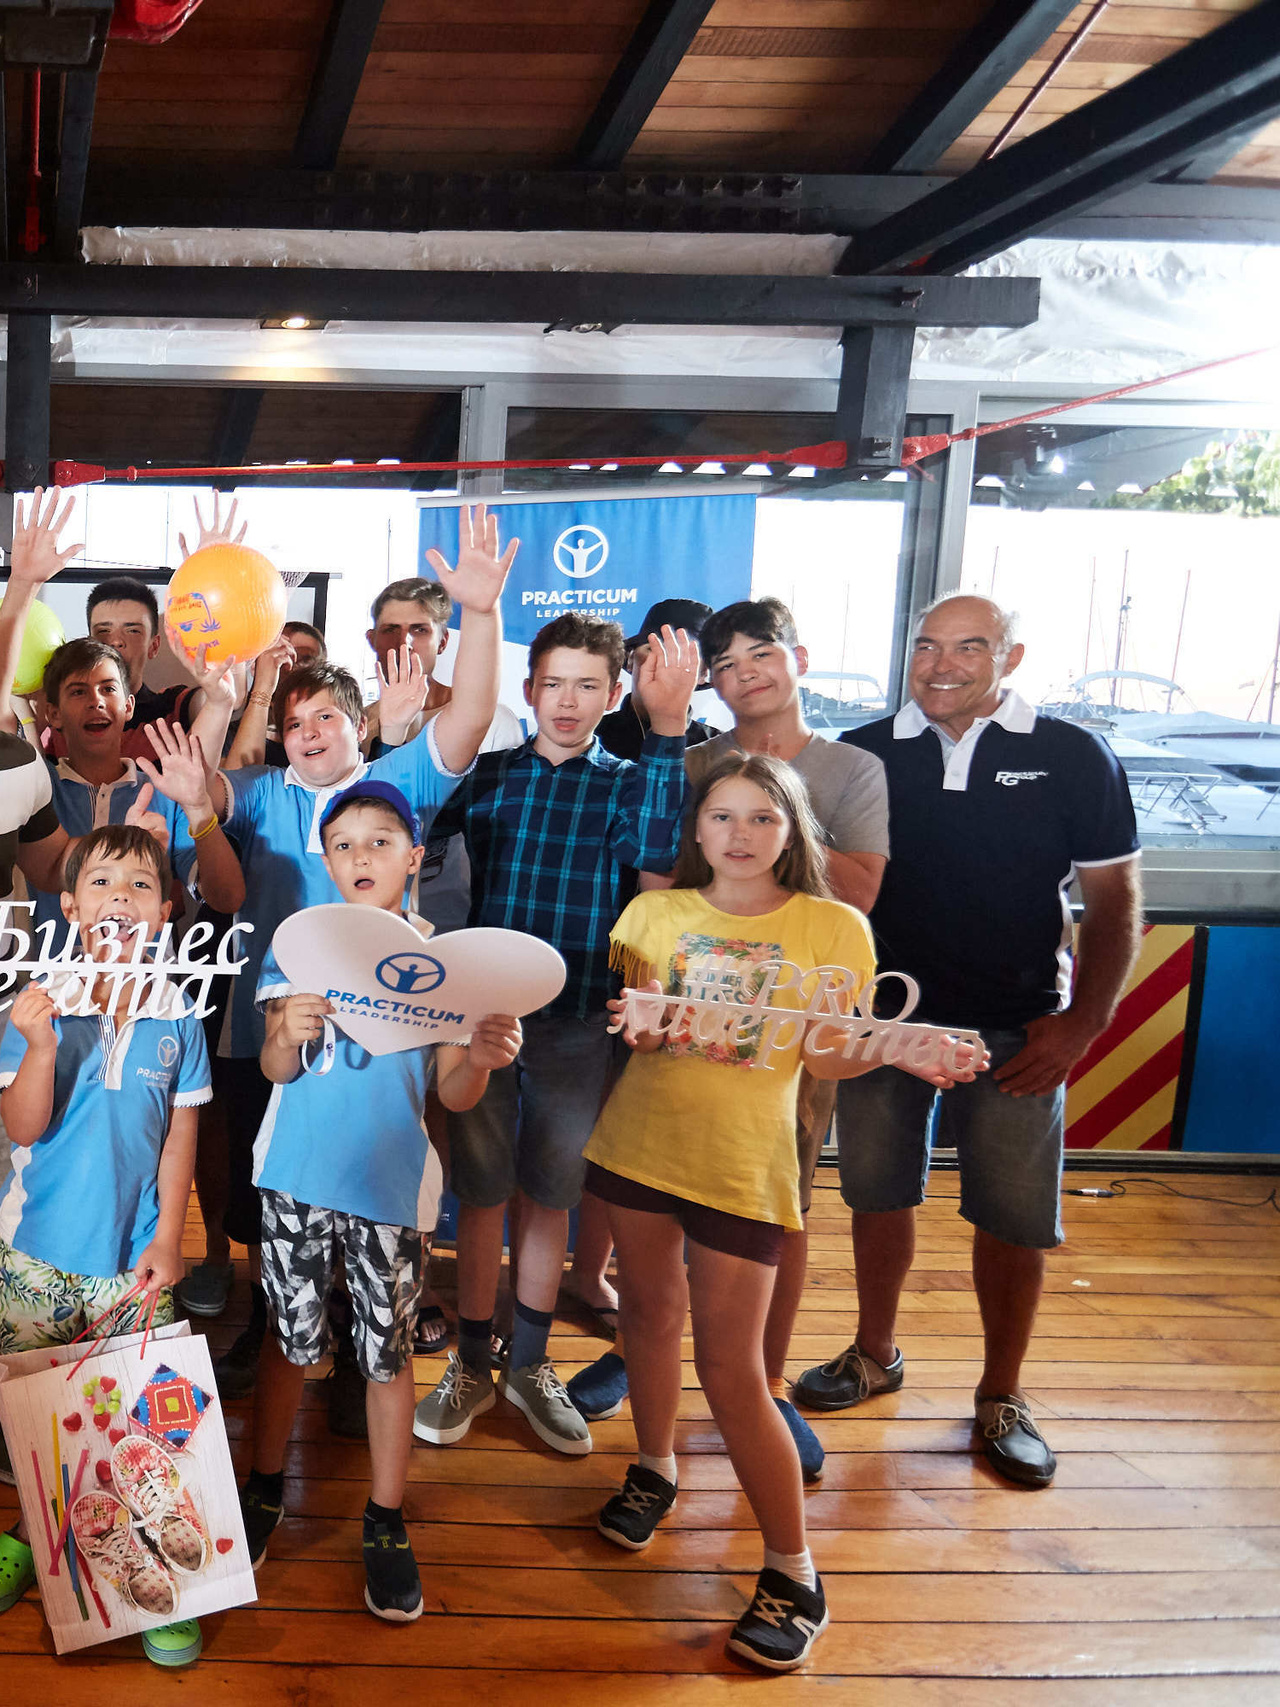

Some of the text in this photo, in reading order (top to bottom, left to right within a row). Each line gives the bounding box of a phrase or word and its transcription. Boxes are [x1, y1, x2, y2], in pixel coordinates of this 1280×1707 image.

[521, 588, 638, 606] PRACTICUM
[536, 608, 621, 618] LEARSHIP
[682, 953, 921, 1023] #PRO
[325, 989, 466, 1025] PRACTICUM
[339, 1007, 439, 1029] LEADERSHIP
